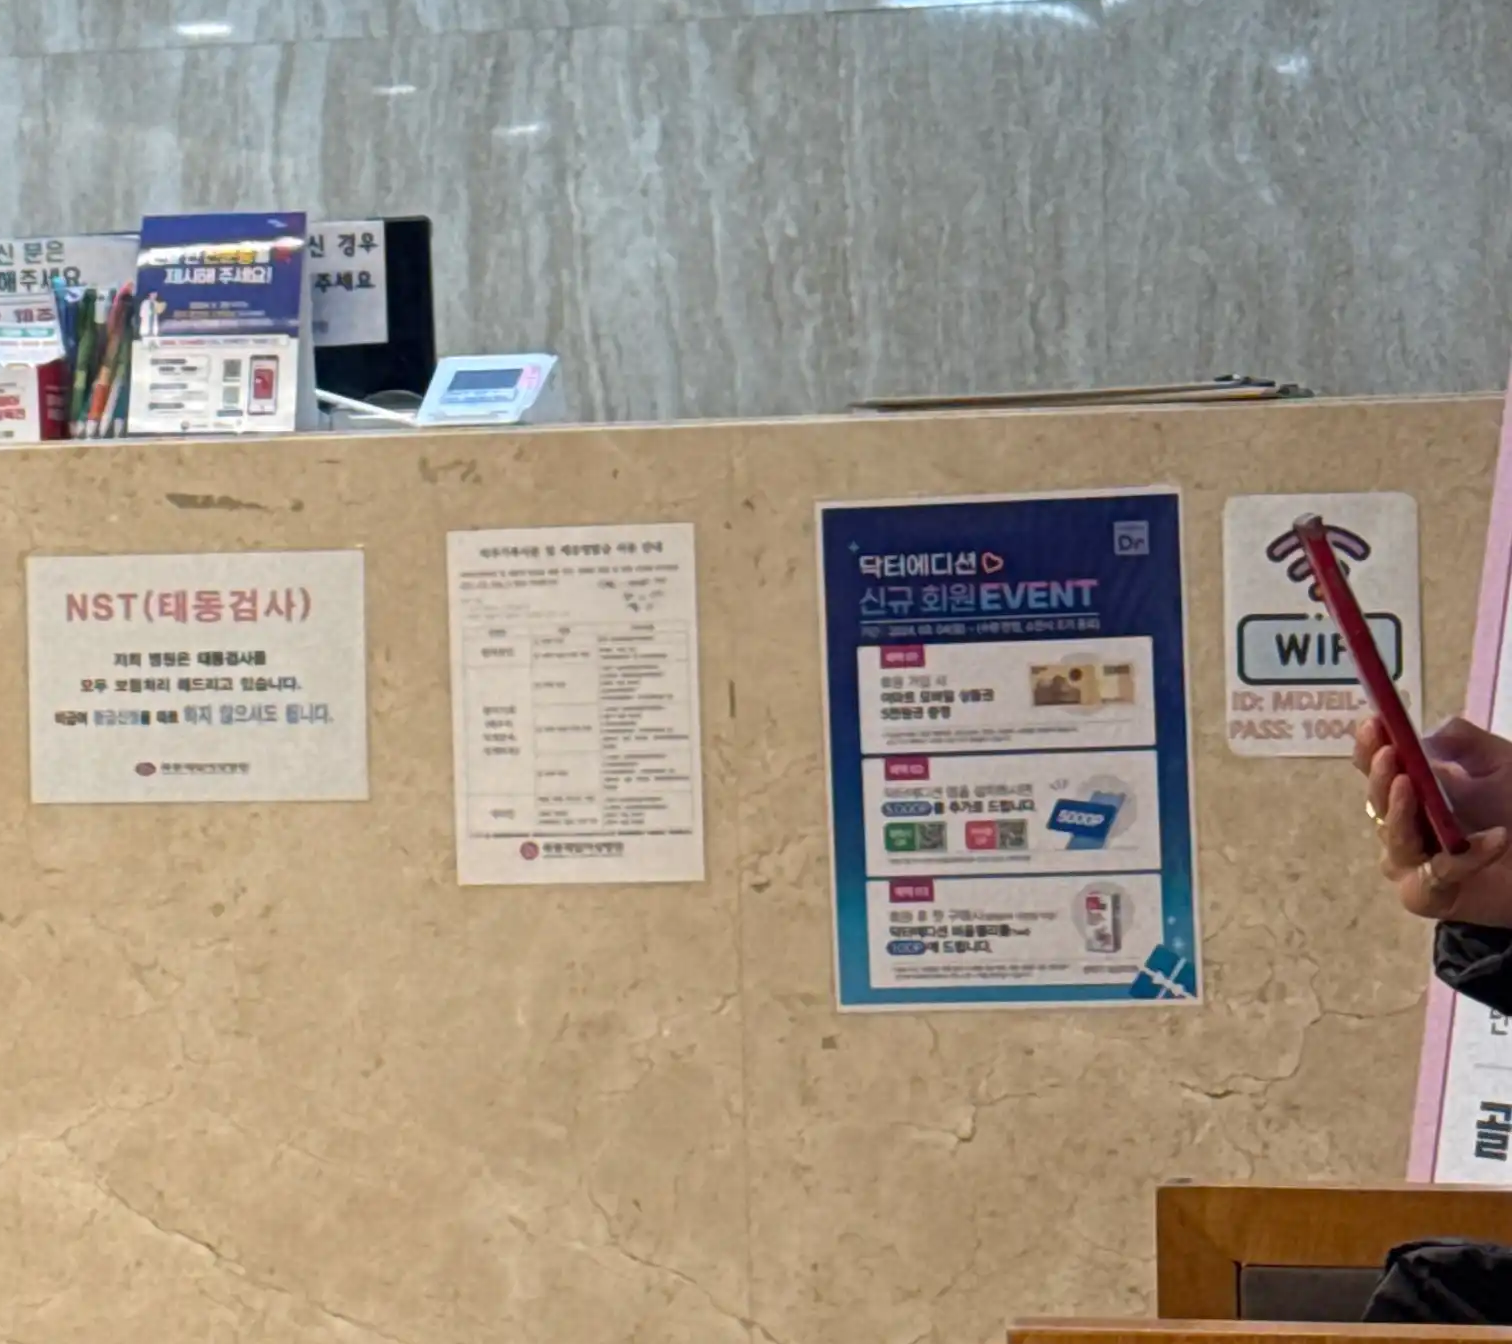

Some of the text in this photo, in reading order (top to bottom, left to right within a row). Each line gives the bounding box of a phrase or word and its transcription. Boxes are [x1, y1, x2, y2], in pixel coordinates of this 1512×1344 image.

[338, 232, 378, 257] 경우
[314, 270, 376, 293] 주세요
[859, 551, 977, 578] 닥터에디션
[65, 587, 312, 624] NST(태동검사)
[859, 579, 1099, 615] 신규 회원 EVENT
[1275, 633, 1350, 666] WIF
[241, 676, 302, 692] 있습니다.
[1232, 690, 1264, 711] ID:
[1229, 719, 1293, 740] PASS:
